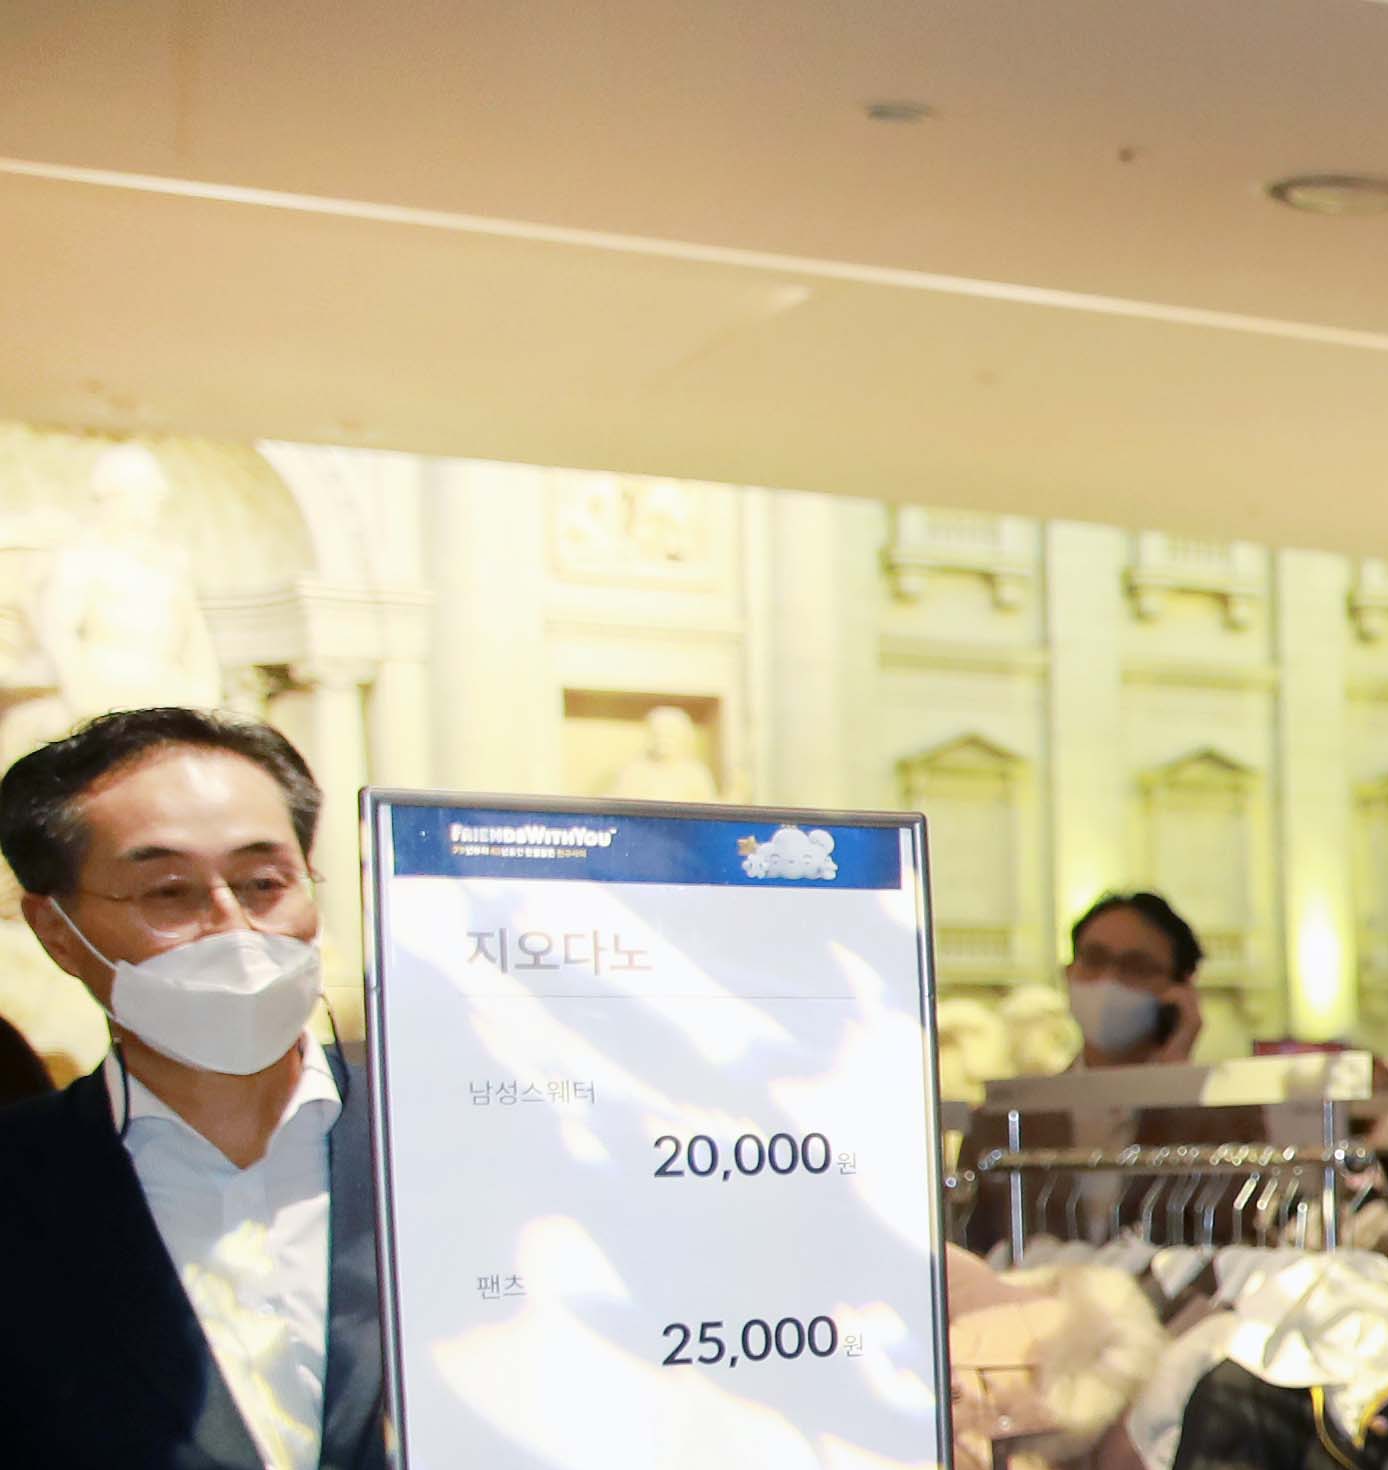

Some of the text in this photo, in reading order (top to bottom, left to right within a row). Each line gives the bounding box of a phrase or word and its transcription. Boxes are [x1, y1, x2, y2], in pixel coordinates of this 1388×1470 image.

[466, 928, 653, 976] 지오다노
[469, 1079, 597, 1106] 남성스웨터
[476, 1274, 528, 1300] 팬츠
